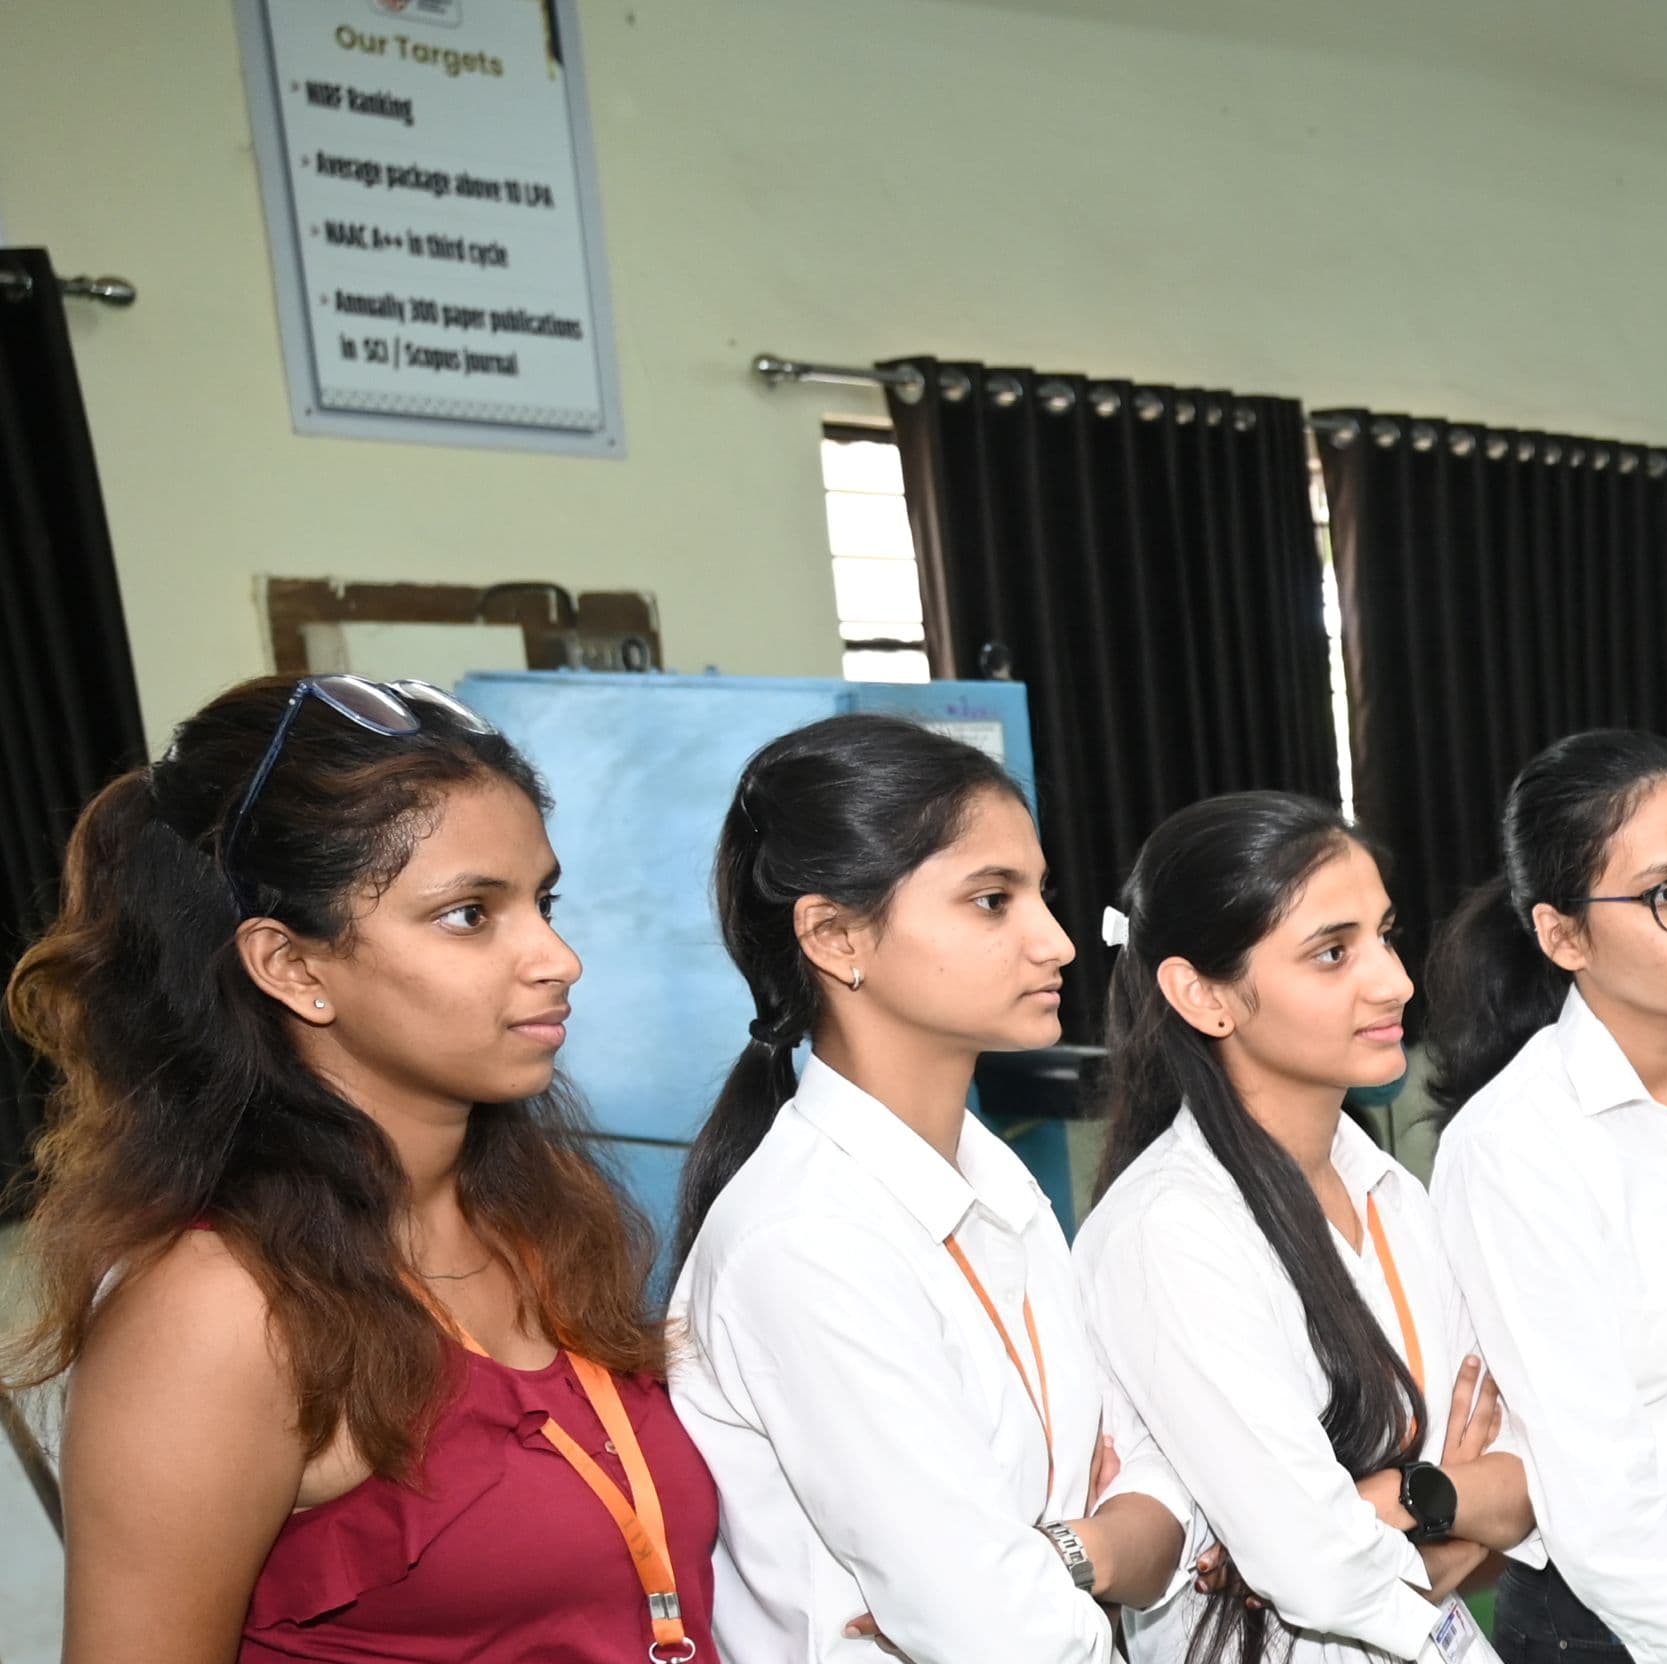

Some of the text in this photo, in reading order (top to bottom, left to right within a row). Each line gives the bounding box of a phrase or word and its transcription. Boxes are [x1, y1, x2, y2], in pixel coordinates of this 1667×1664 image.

[335, 24, 504, 78] Our Targets
[347, 88, 414, 127] Ranking
[316, 150, 383, 188] Average
[386, 160, 450, 199] package
[455, 174, 502, 203] above
[408, 230, 424, 254] in
[427, 233, 466, 262] third
[469, 241, 509, 268] cycle
[442, 305, 486, 335] paper
[490, 306, 583, 340] publications
[340, 335, 358, 360] in
[464, 347, 519, 377] journal
